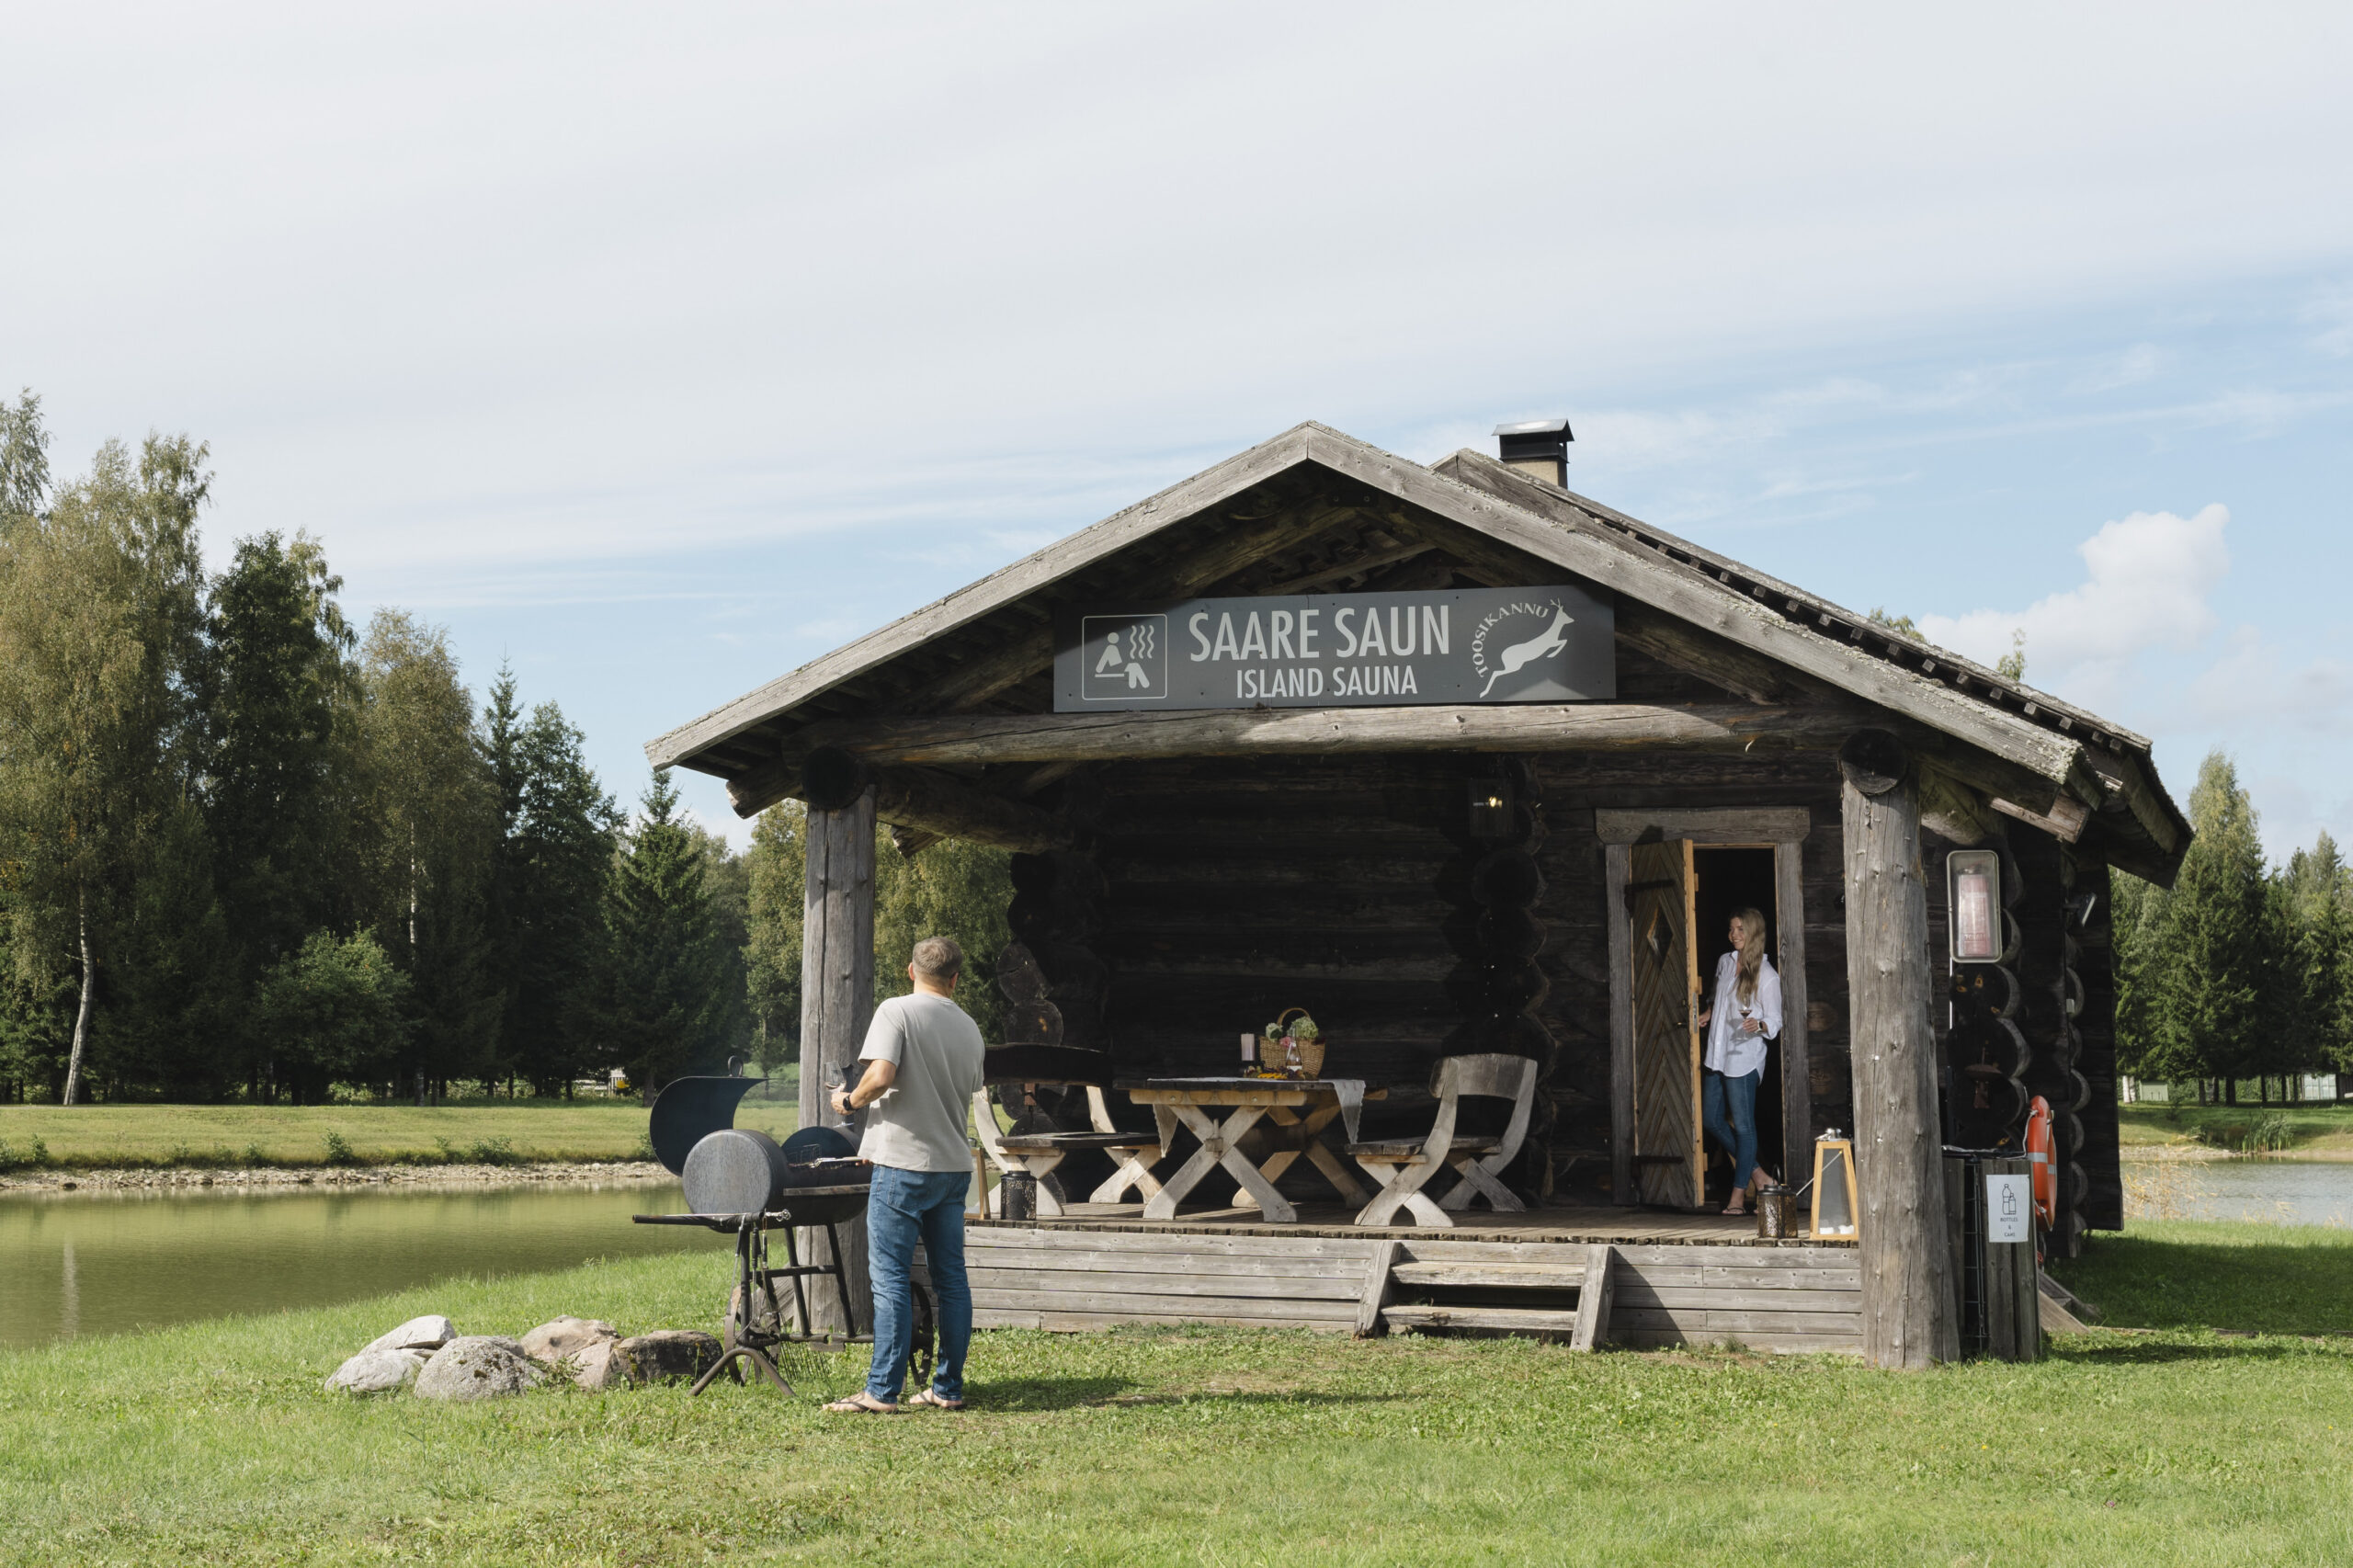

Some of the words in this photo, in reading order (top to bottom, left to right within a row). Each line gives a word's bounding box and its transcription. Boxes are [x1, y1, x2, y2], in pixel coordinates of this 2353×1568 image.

[1188, 609, 1320, 662] SAARE
[1335, 605, 1449, 658] SAUN
[1472, 602, 1549, 678] TOOSIKANNU
[1236, 667, 1324, 699] ISLAND
[1333, 665, 1418, 697] SAUNA
